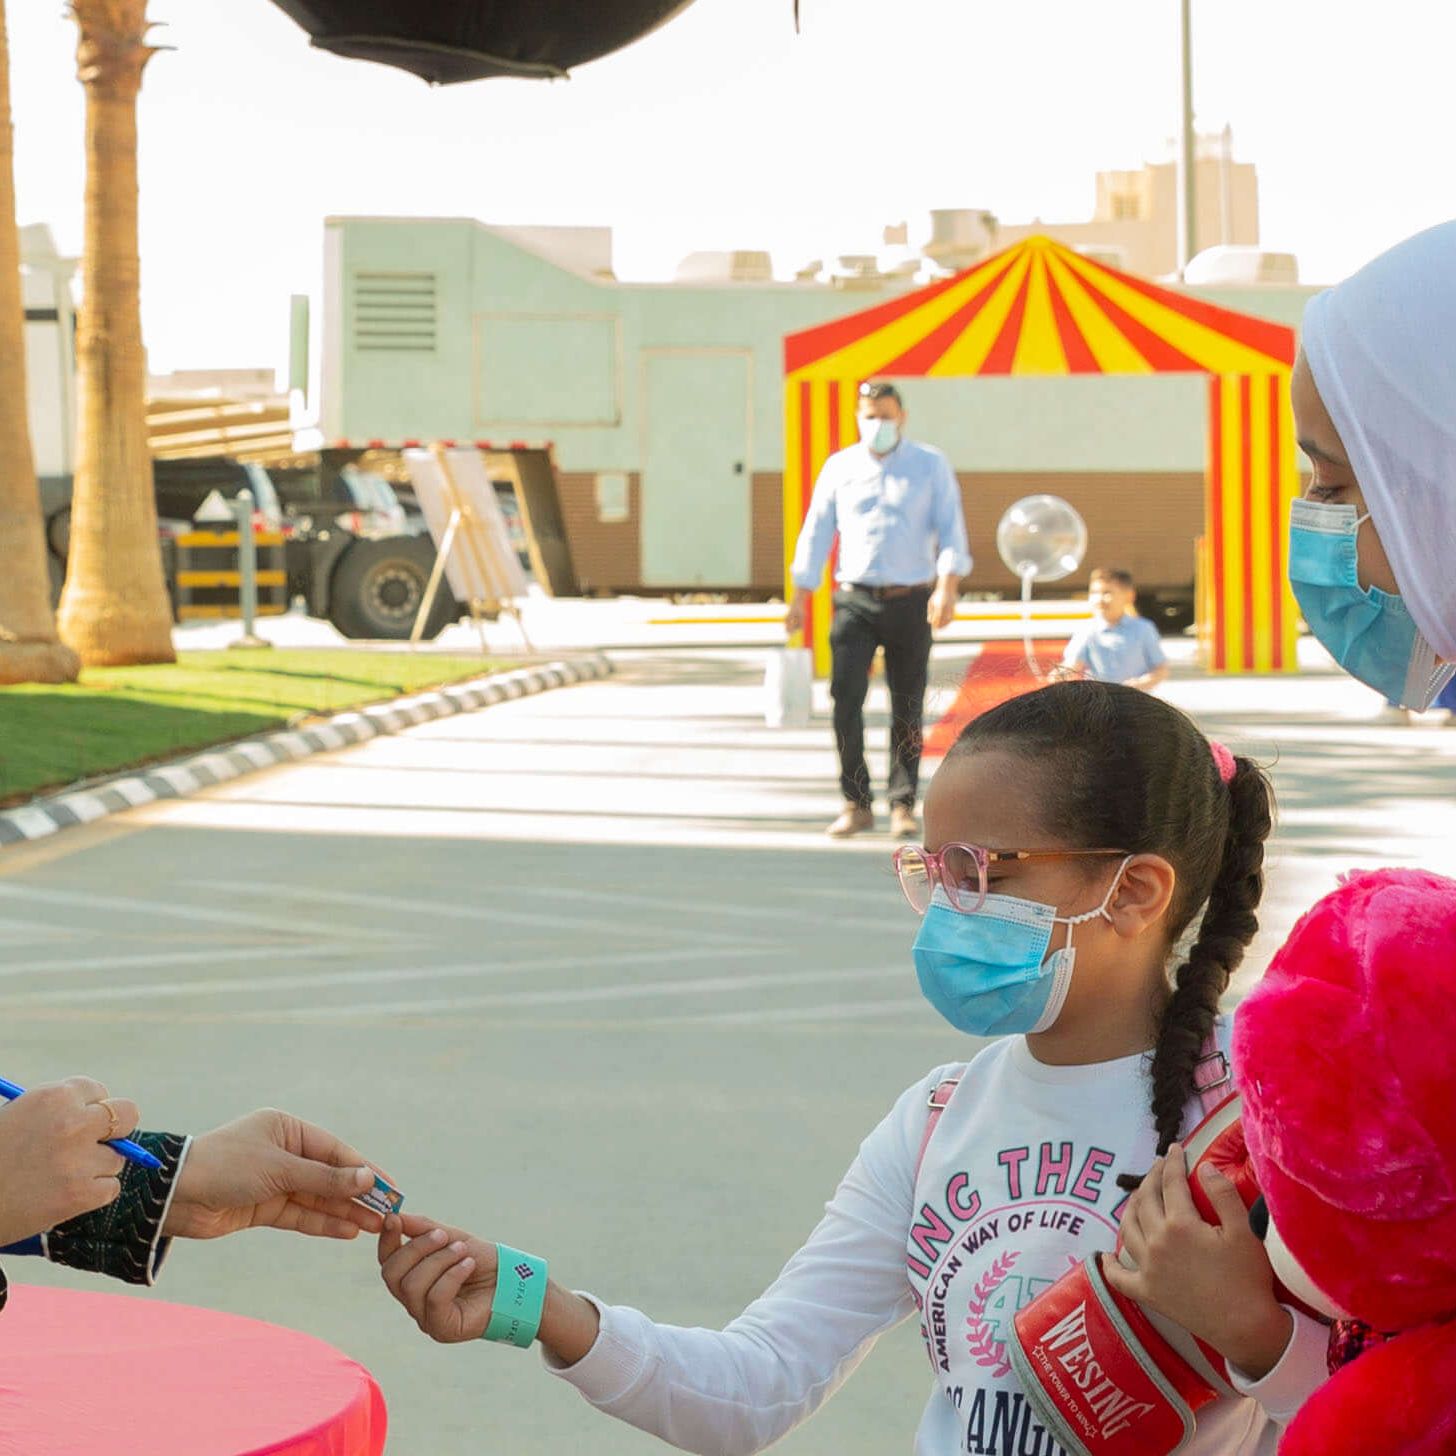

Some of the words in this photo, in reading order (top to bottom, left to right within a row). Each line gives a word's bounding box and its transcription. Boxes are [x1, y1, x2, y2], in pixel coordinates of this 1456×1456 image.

[998, 1141, 1115, 1203] THE
[932, 1255, 963, 1373] AMERICAN
[962, 1219, 999, 1254] WAY
[1008, 1211, 1035, 1233] OF
[1039, 1210, 1085, 1235] LIFE
[1039, 1300, 1155, 1440] WESING
[1049, 1371, 1071, 1401] POWER
[1067, 1399, 1079, 1412] TO
